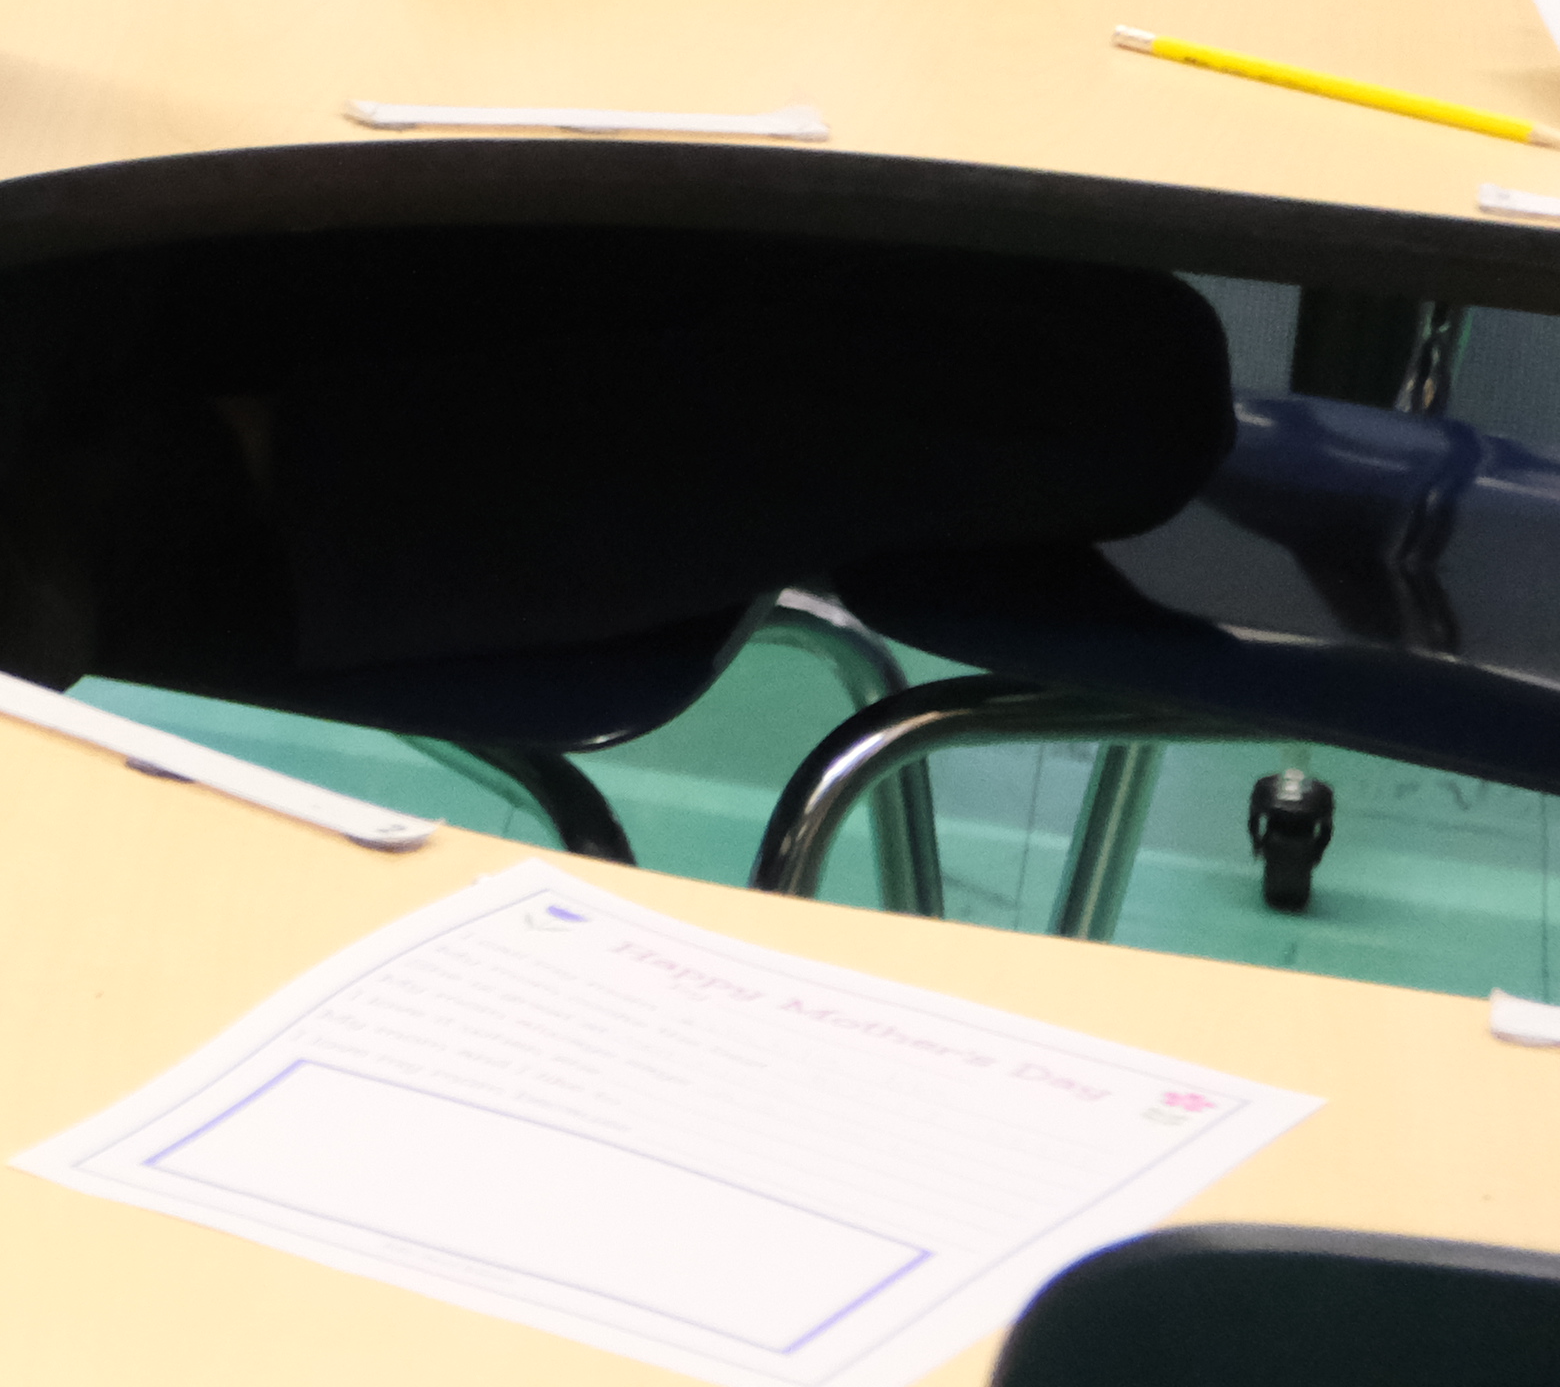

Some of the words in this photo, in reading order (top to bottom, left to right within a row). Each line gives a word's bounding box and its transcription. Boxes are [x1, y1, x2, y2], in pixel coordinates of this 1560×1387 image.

[609, 940, 766, 1003] Happy
[775, 996, 998, 1069] Mother's
[1008, 1061, 1114, 1103] Day
